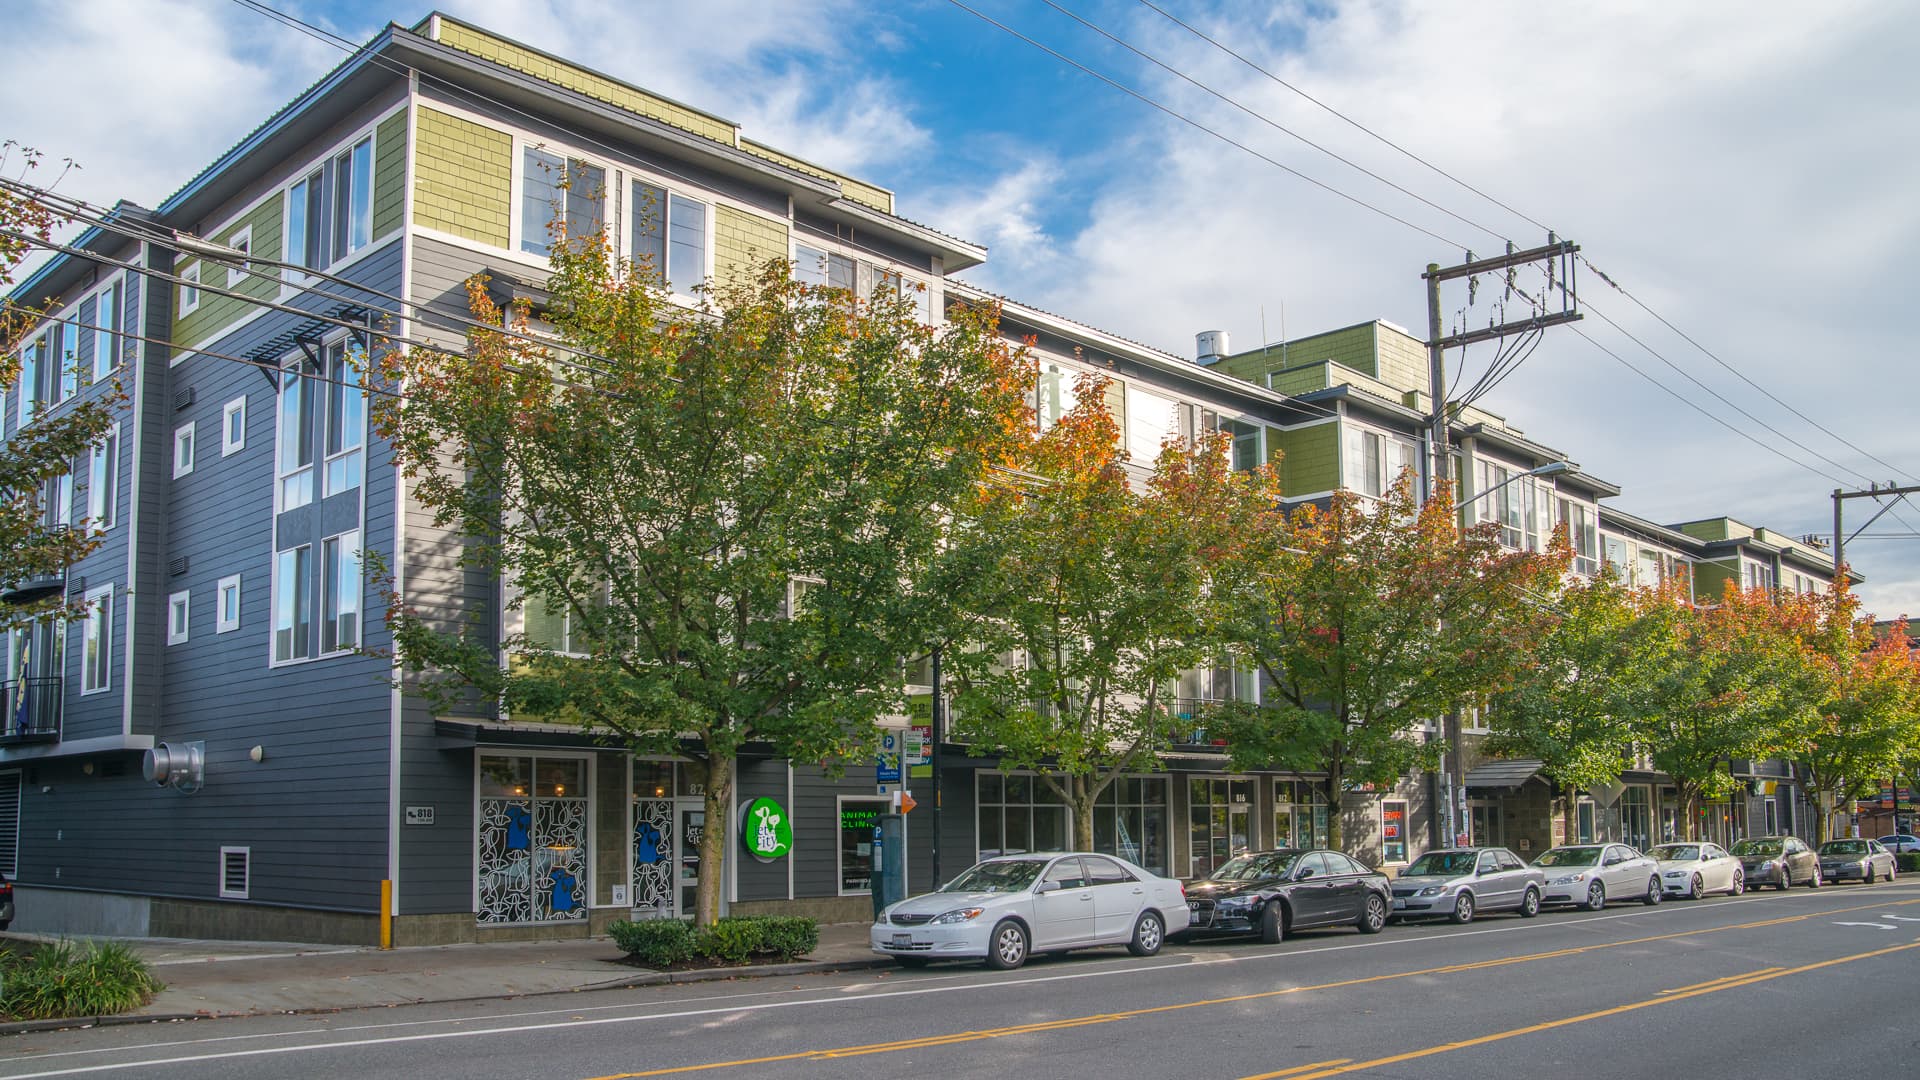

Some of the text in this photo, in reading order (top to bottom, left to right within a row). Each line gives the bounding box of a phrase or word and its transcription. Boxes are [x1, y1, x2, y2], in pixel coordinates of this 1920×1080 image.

[689, 783, 704, 795] 82
[1236, 793, 1246, 802] 816
[1278, 794, 1287, 802] 812
[417, 808, 433, 818] 818
[686, 823, 699, 837] jet
[753, 822, 769, 837] jet
[688, 834, 703, 845] cit
[755, 835, 776, 850] city
